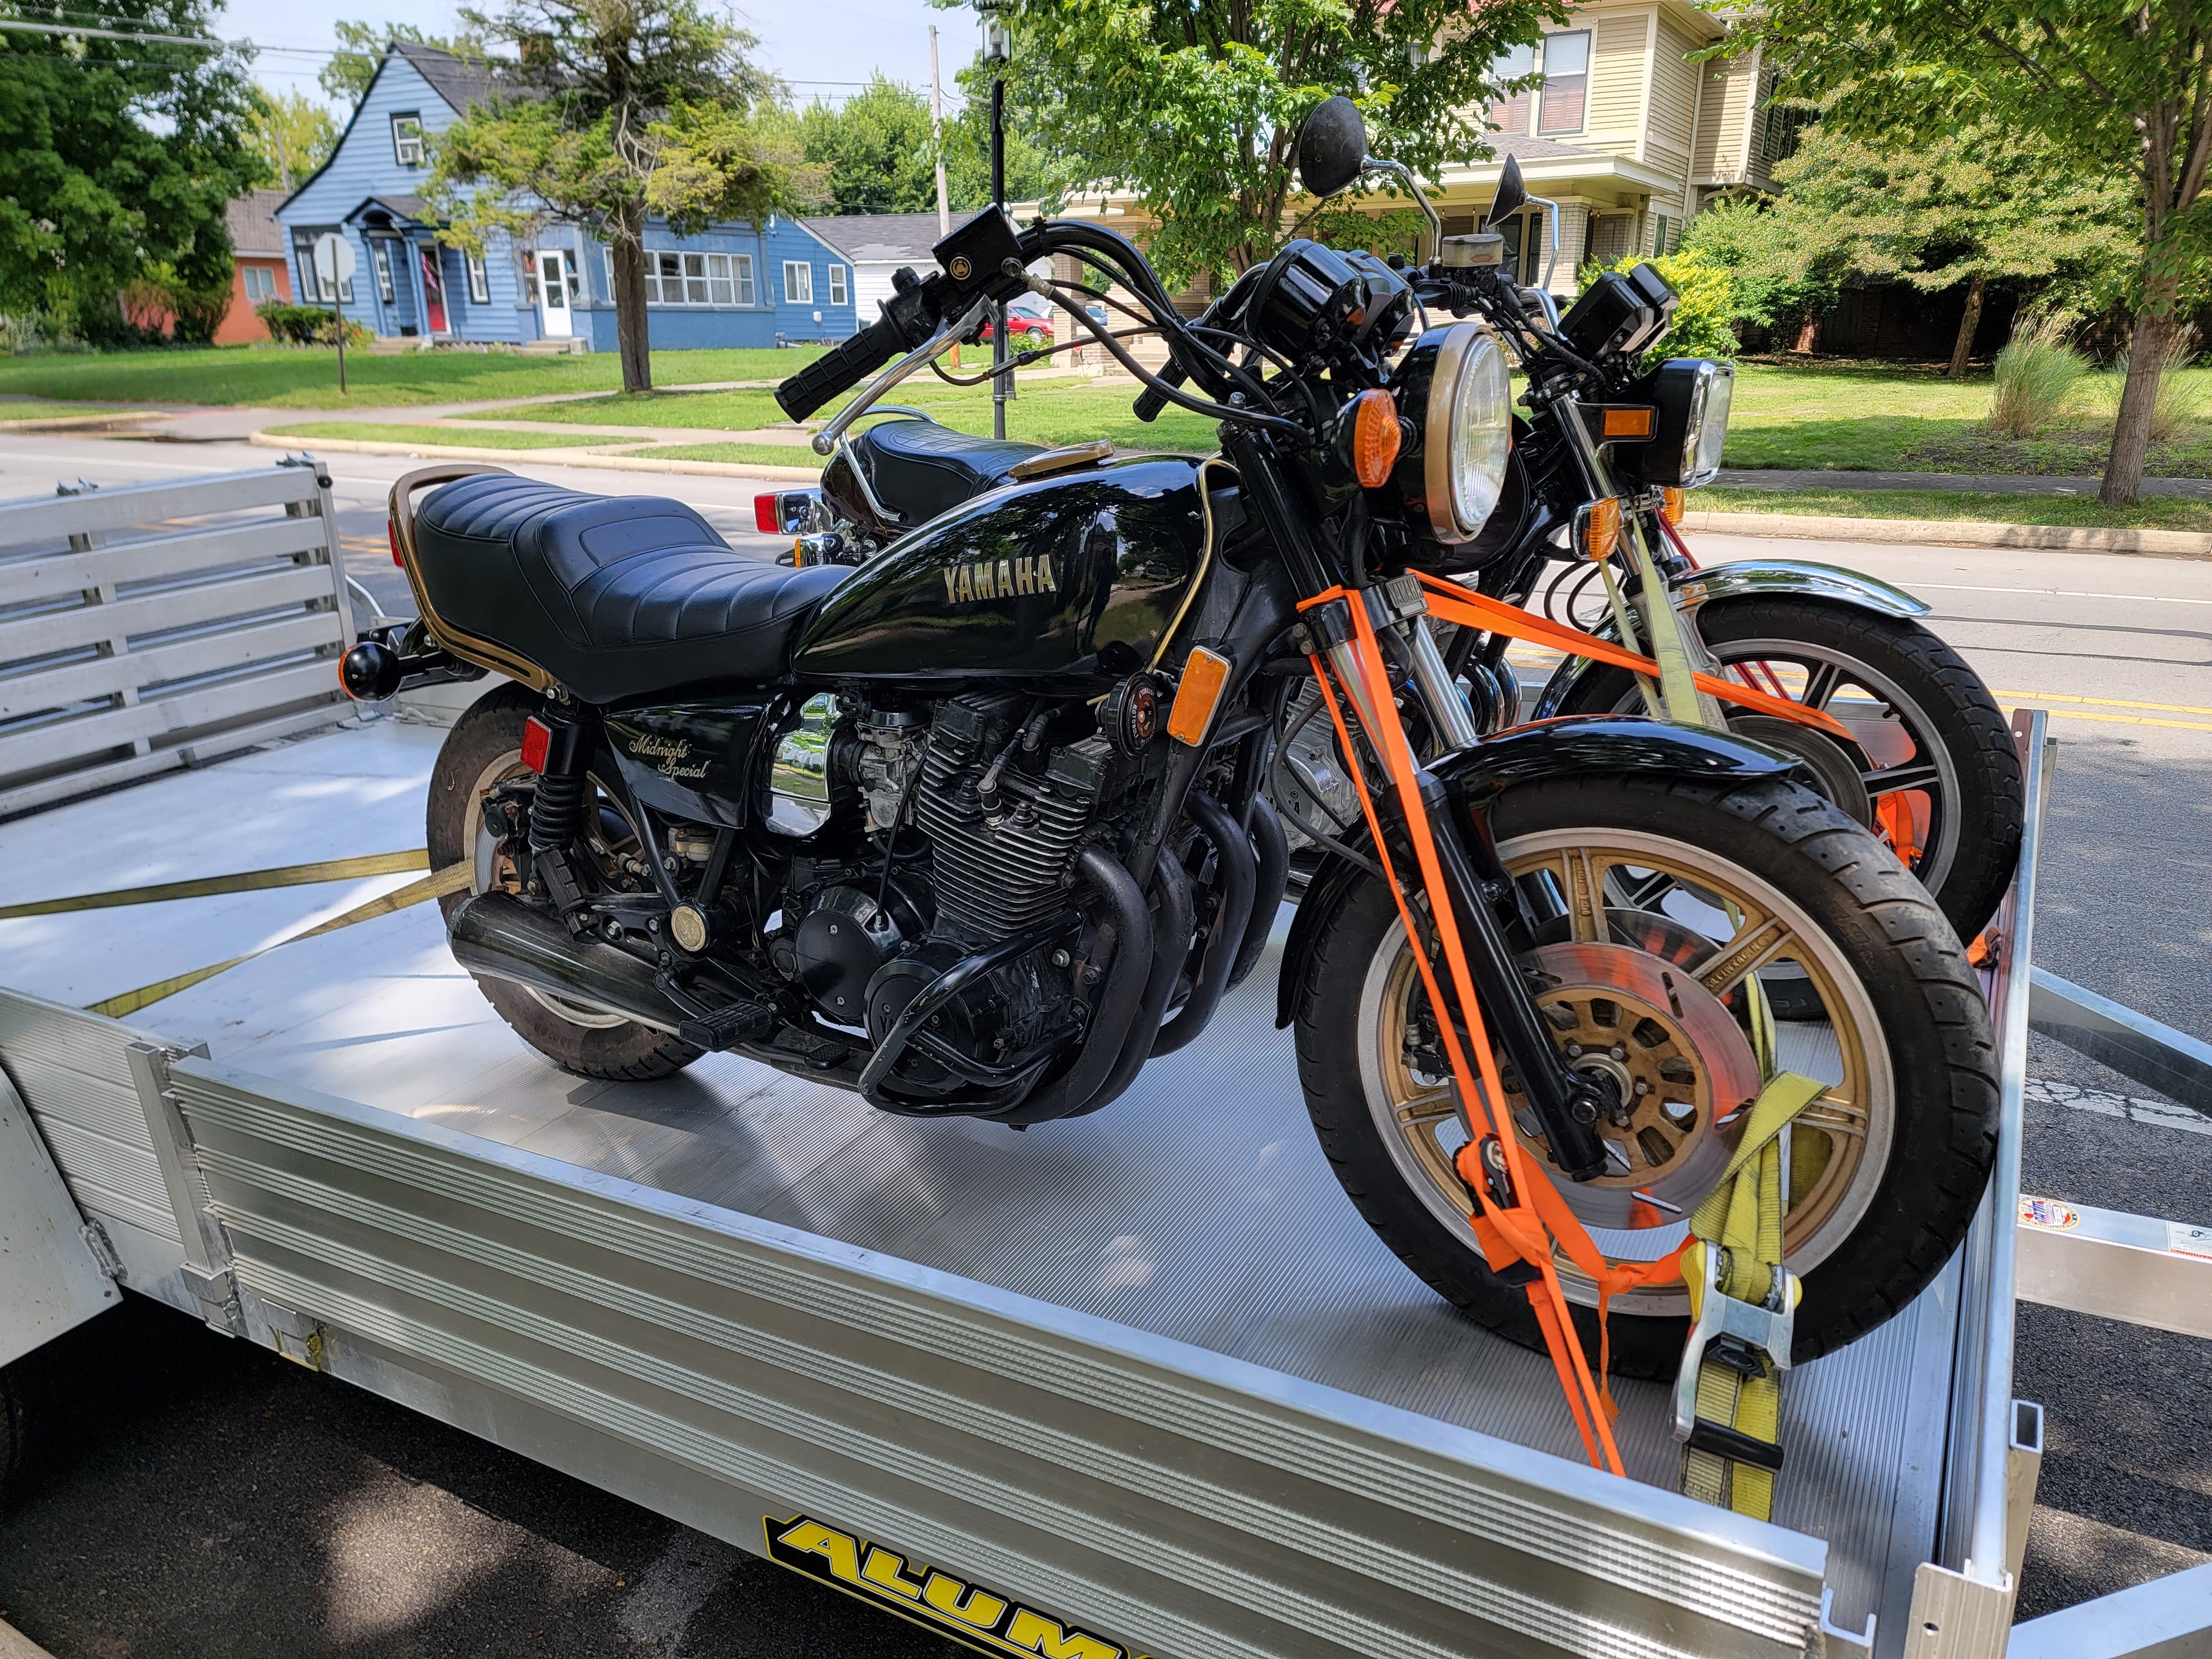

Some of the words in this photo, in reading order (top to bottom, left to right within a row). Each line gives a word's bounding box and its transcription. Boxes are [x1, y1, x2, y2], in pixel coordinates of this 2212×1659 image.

[943, 554, 1057, 604] YAMAHA
[1388, 577, 1425, 606] YAMAHA
[629, 734, 688, 764] Midnight
[658, 758, 711, 781] Special
